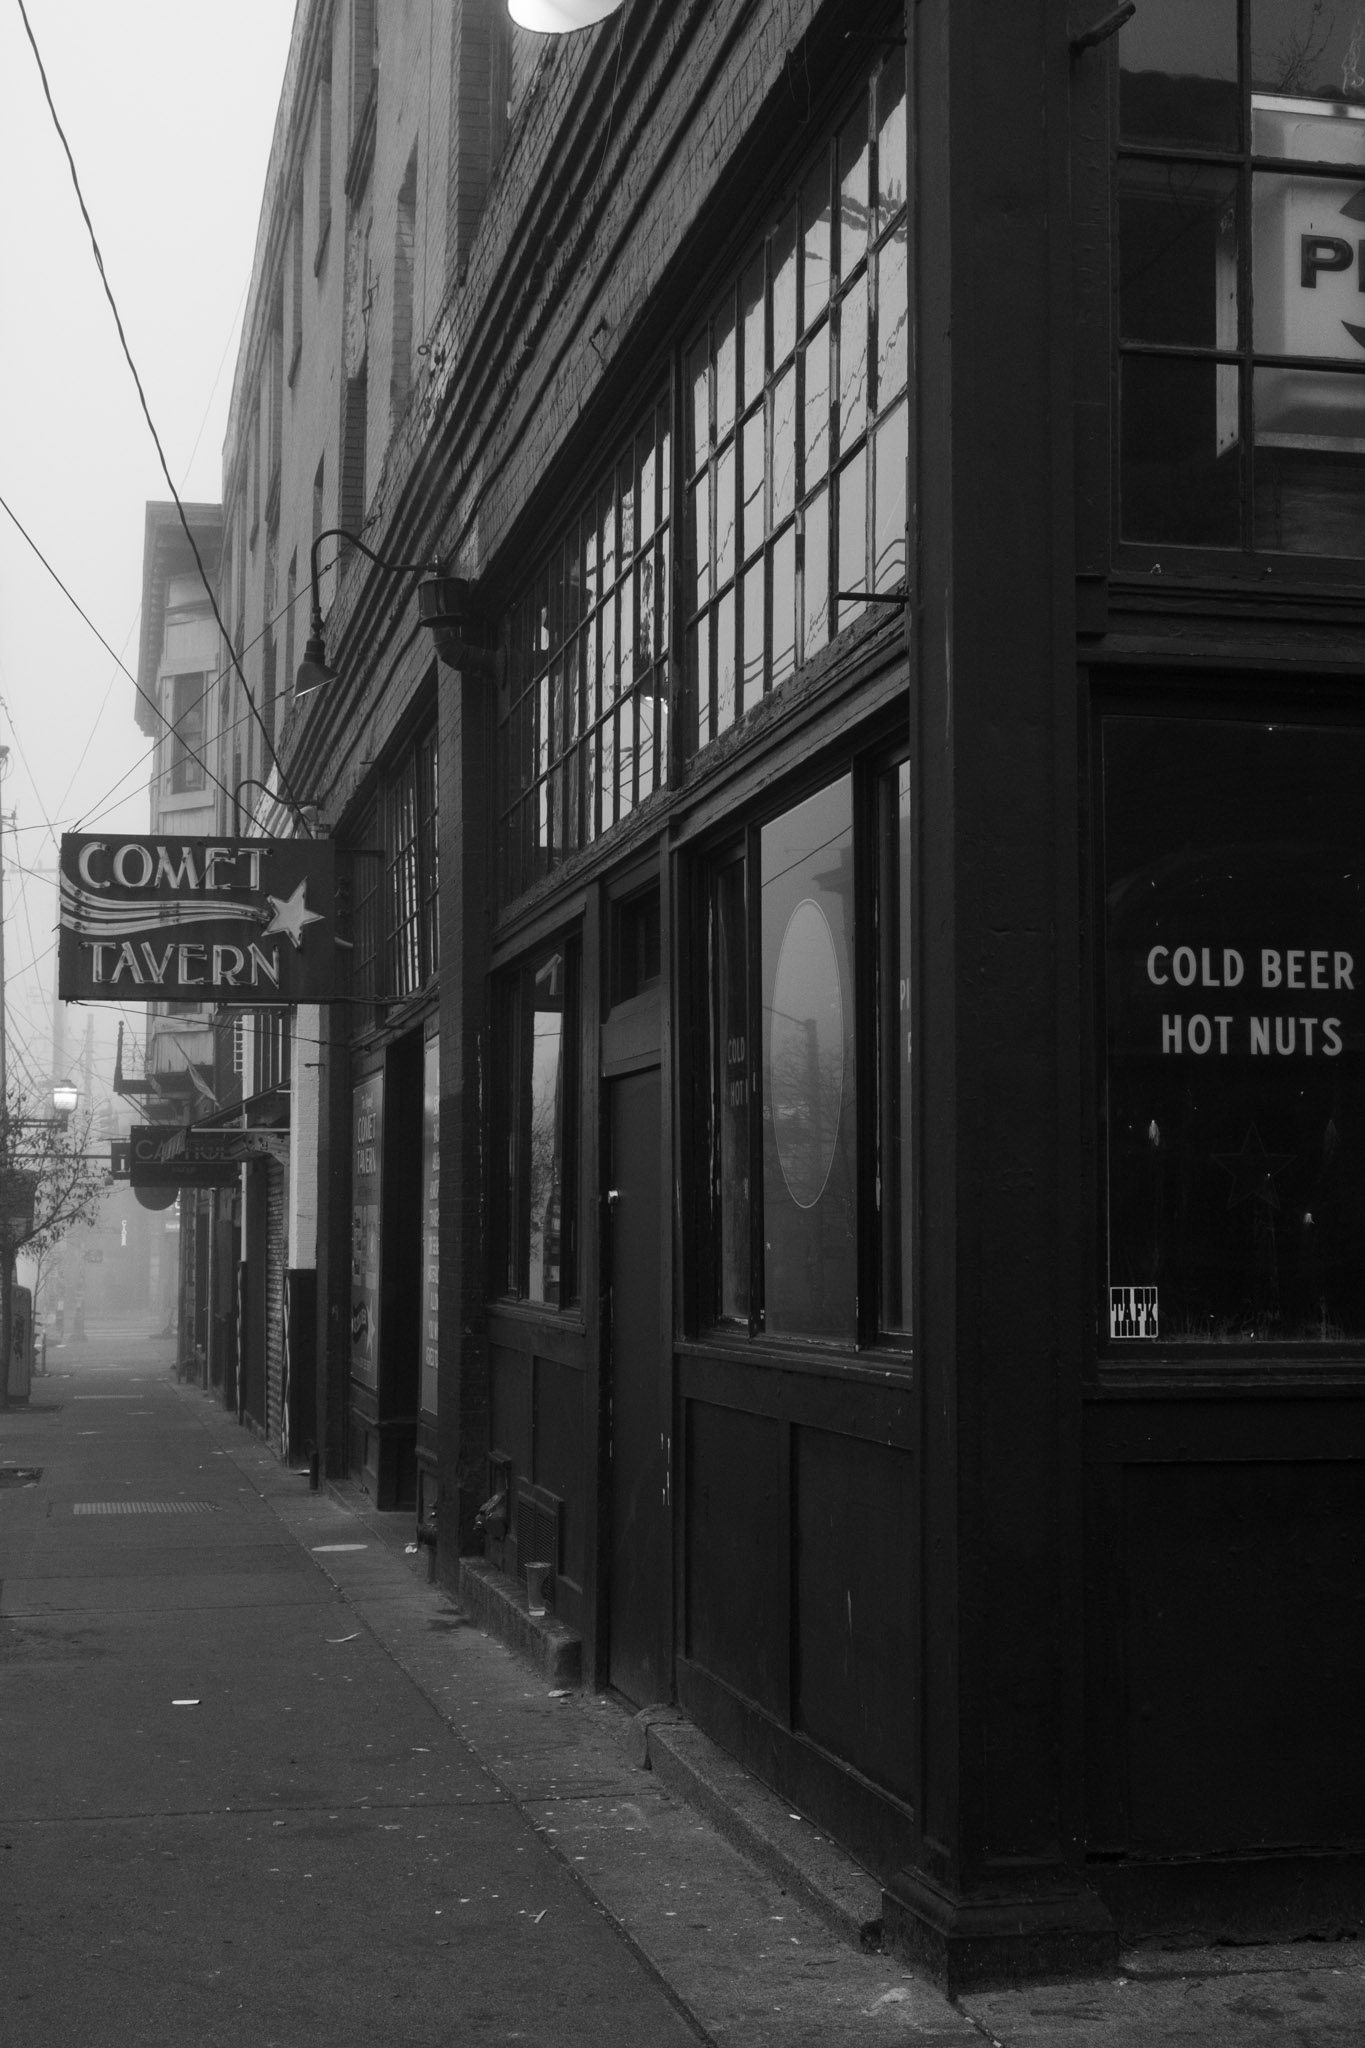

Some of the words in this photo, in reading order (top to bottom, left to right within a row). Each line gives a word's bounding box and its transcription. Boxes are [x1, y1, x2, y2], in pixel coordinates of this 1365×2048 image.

[77, 841, 273, 890] COMET
[78, 941, 280, 990] TAVERN
[1147, 945, 1245, 987] COLD
[1261, 948, 1355, 990] BEER
[727, 1036, 745, 1064] COLD
[1161, 1013, 1234, 1055] HOT
[1250, 1016, 1343, 1056] NUTS
[730, 1080, 744, 1106] HOT
